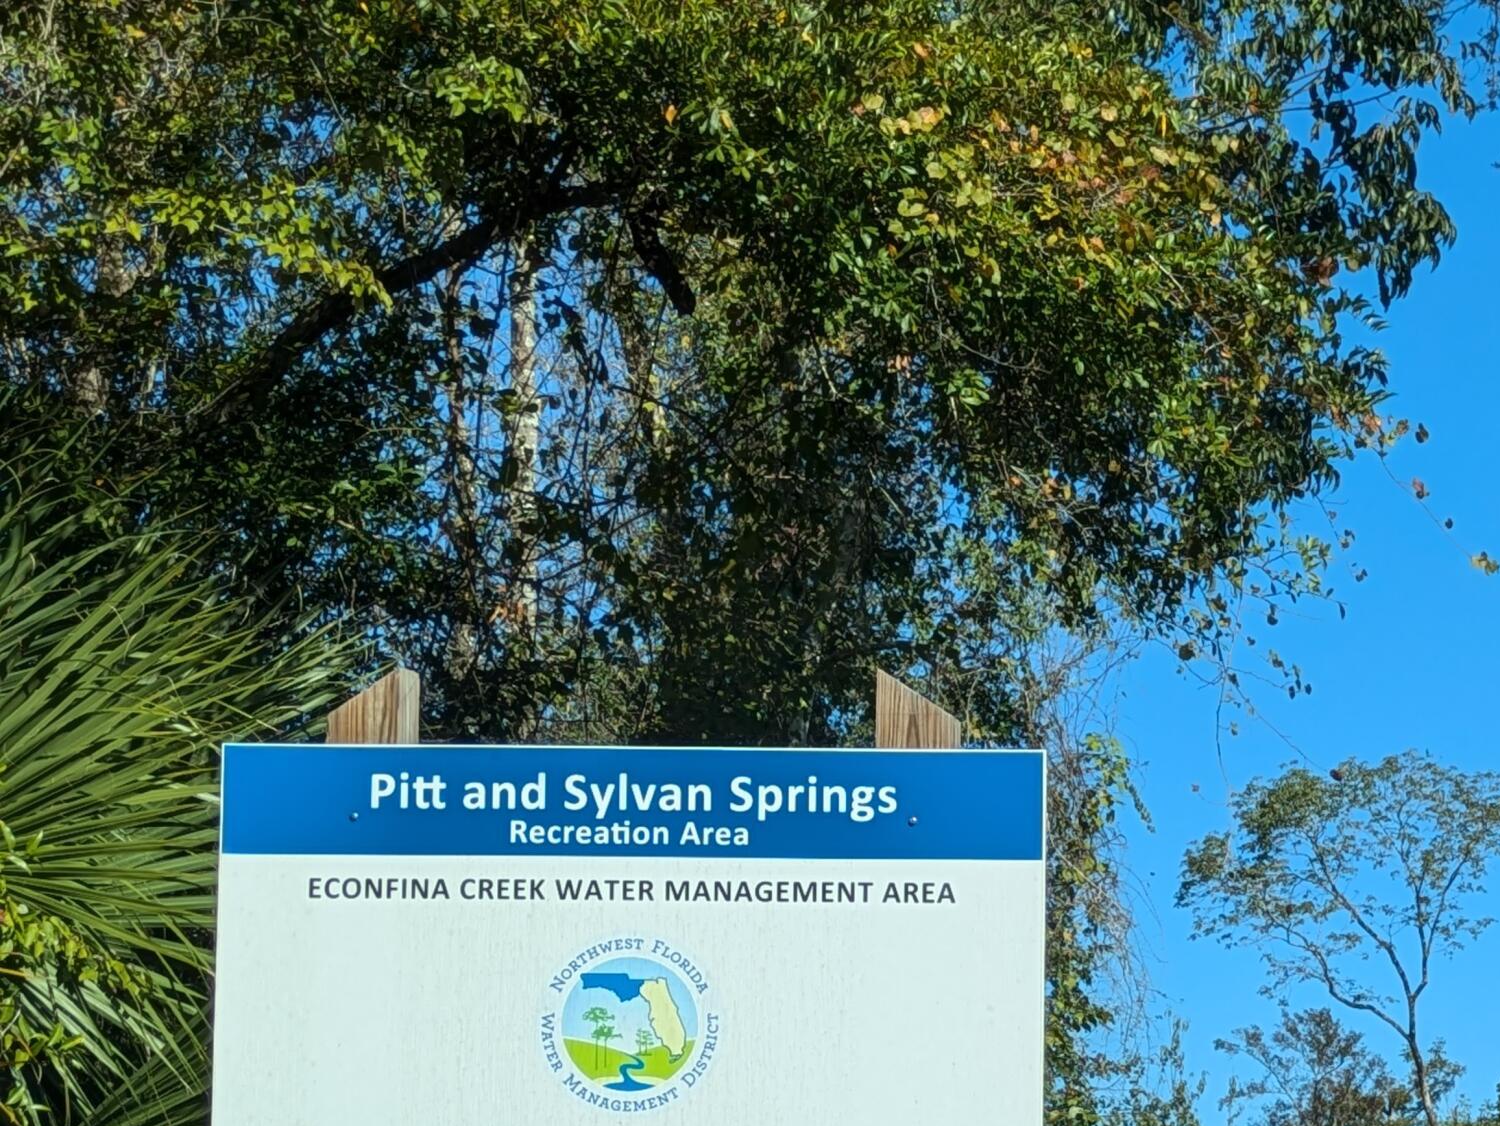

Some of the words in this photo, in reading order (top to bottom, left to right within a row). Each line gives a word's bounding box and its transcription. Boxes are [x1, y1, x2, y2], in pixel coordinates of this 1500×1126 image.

[370, 772, 447, 810] Pitt
[462, 772, 546, 810] and
[564, 772, 712, 819] Sylvan
[729, 775, 897, 822] Springs
[510, 819, 669, 845] Recreation
[679, 821, 749, 846] Area
[308, 877, 450, 900] ECONFINA
[460, 878, 545, 900] CREEK
[555, 879, 654, 901] WATER
[665, 880, 874, 903] MANAGEMENT
[882, 882, 956, 904] AREA
